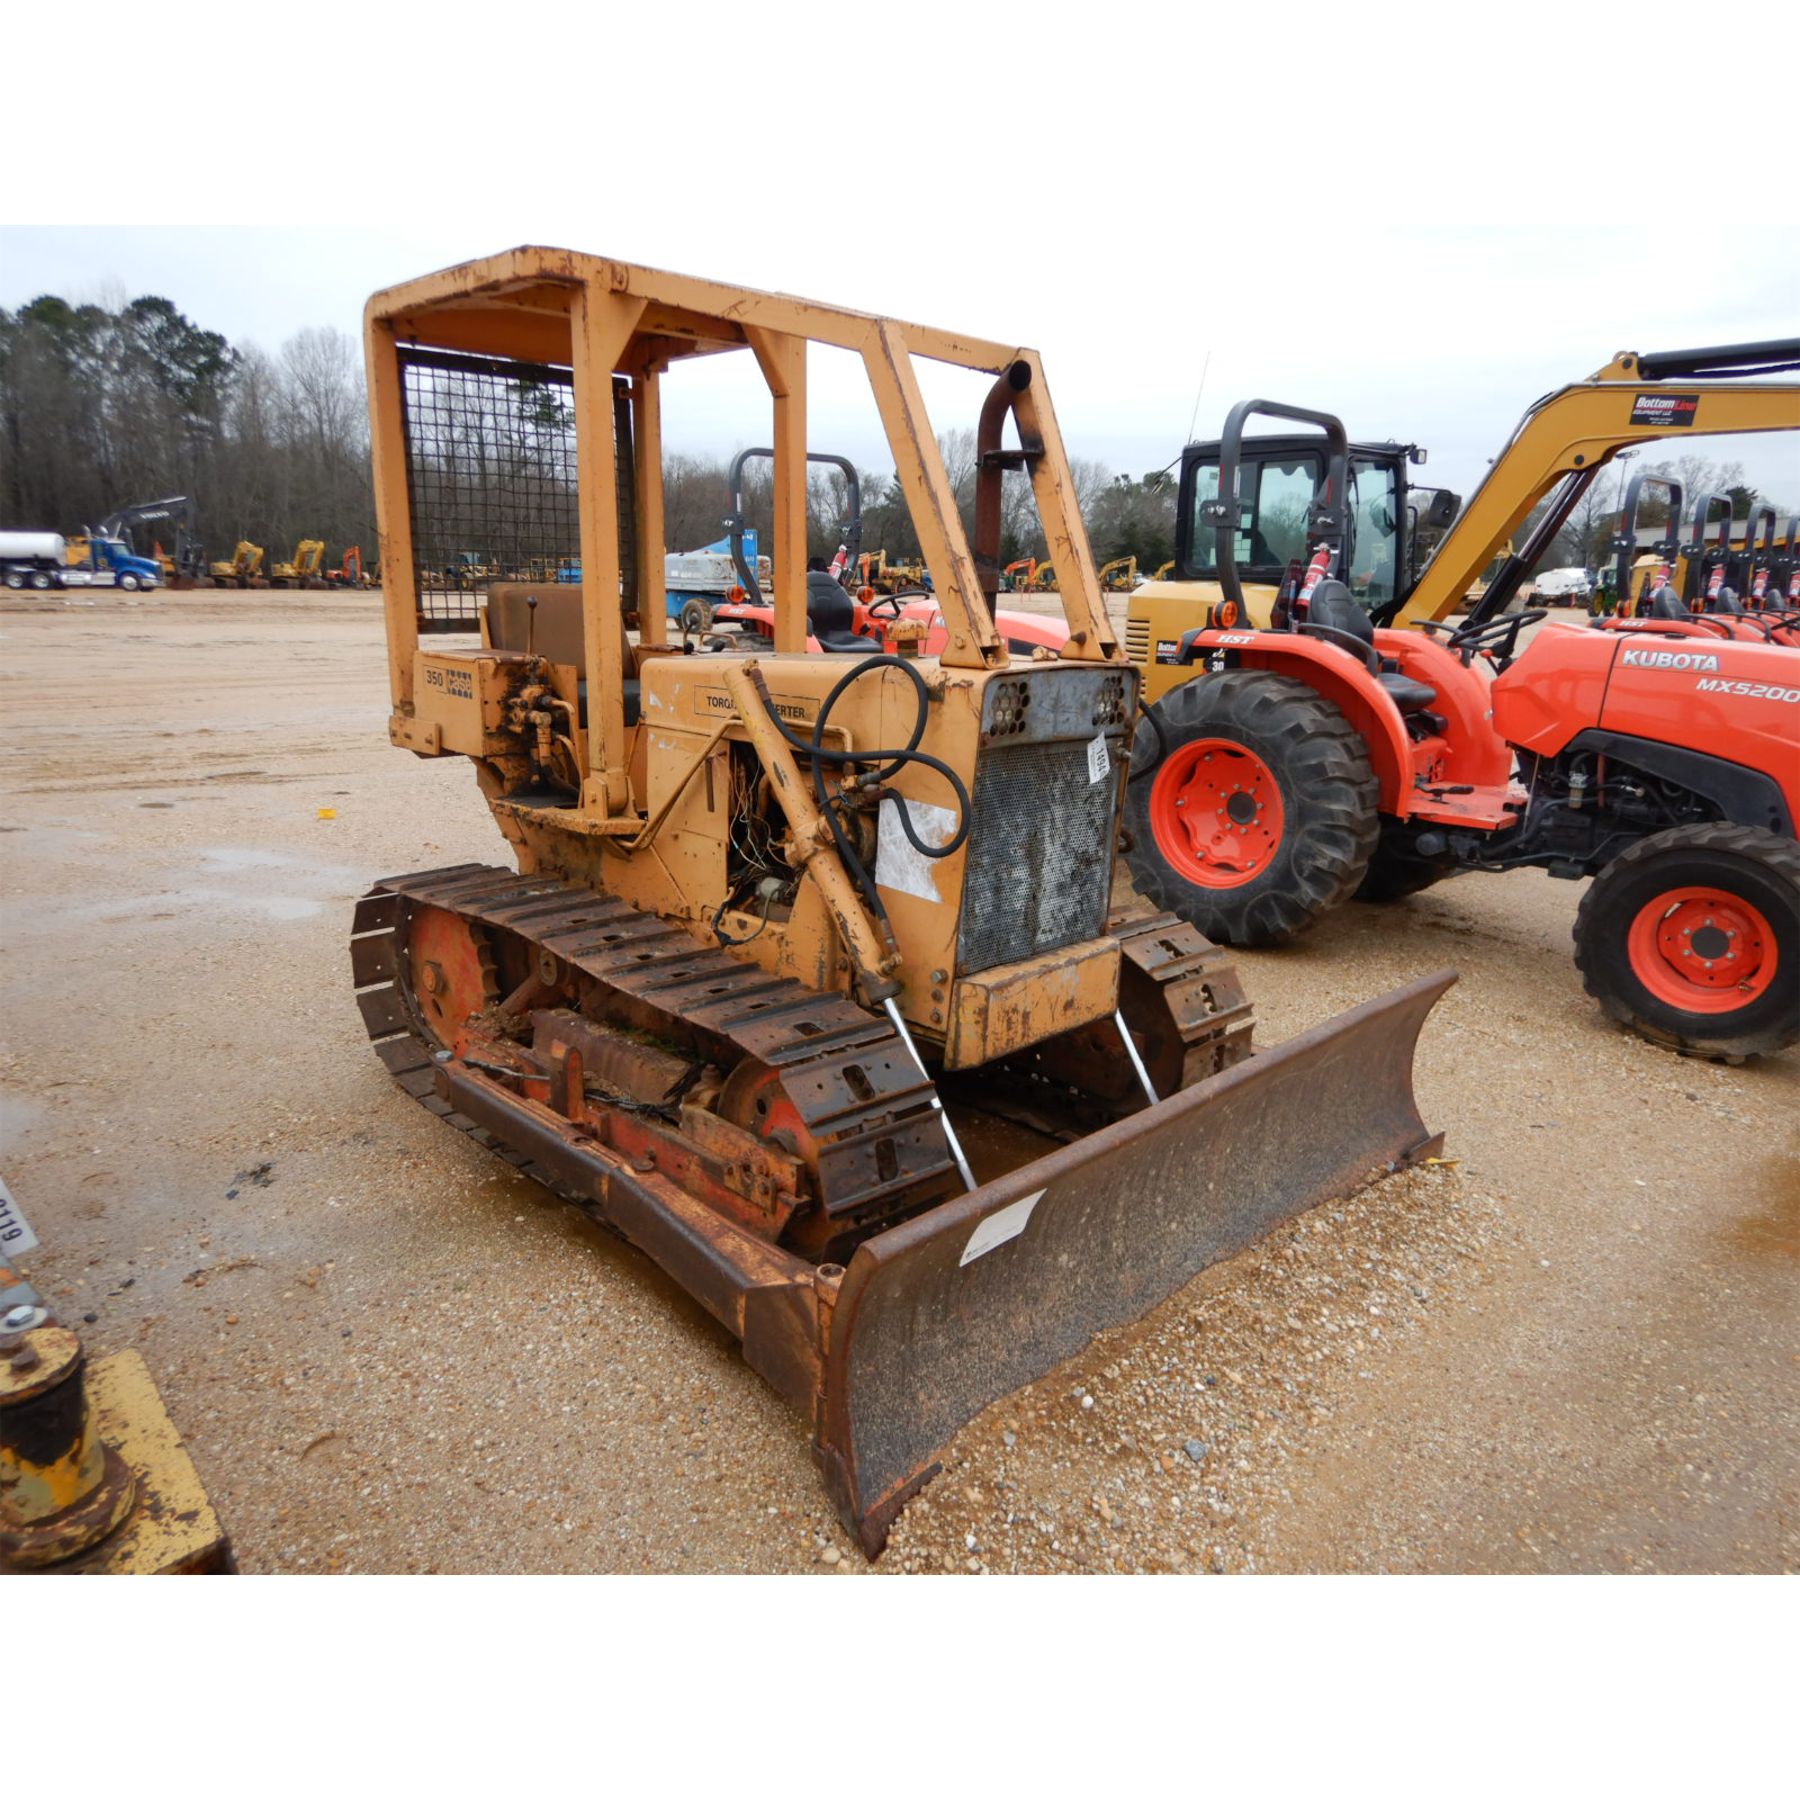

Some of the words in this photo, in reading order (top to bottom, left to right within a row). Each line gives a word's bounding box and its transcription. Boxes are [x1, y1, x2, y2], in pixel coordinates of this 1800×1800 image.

[1215, 634, 1255, 645] HST
[1622, 650, 1720, 672] KUBOTA
[426, 670, 444, 687] 350
[1696, 678, 1800, 704] MX5200
[706, 696, 737, 710] TORQ
[775, 704, 806, 718] ERTER
